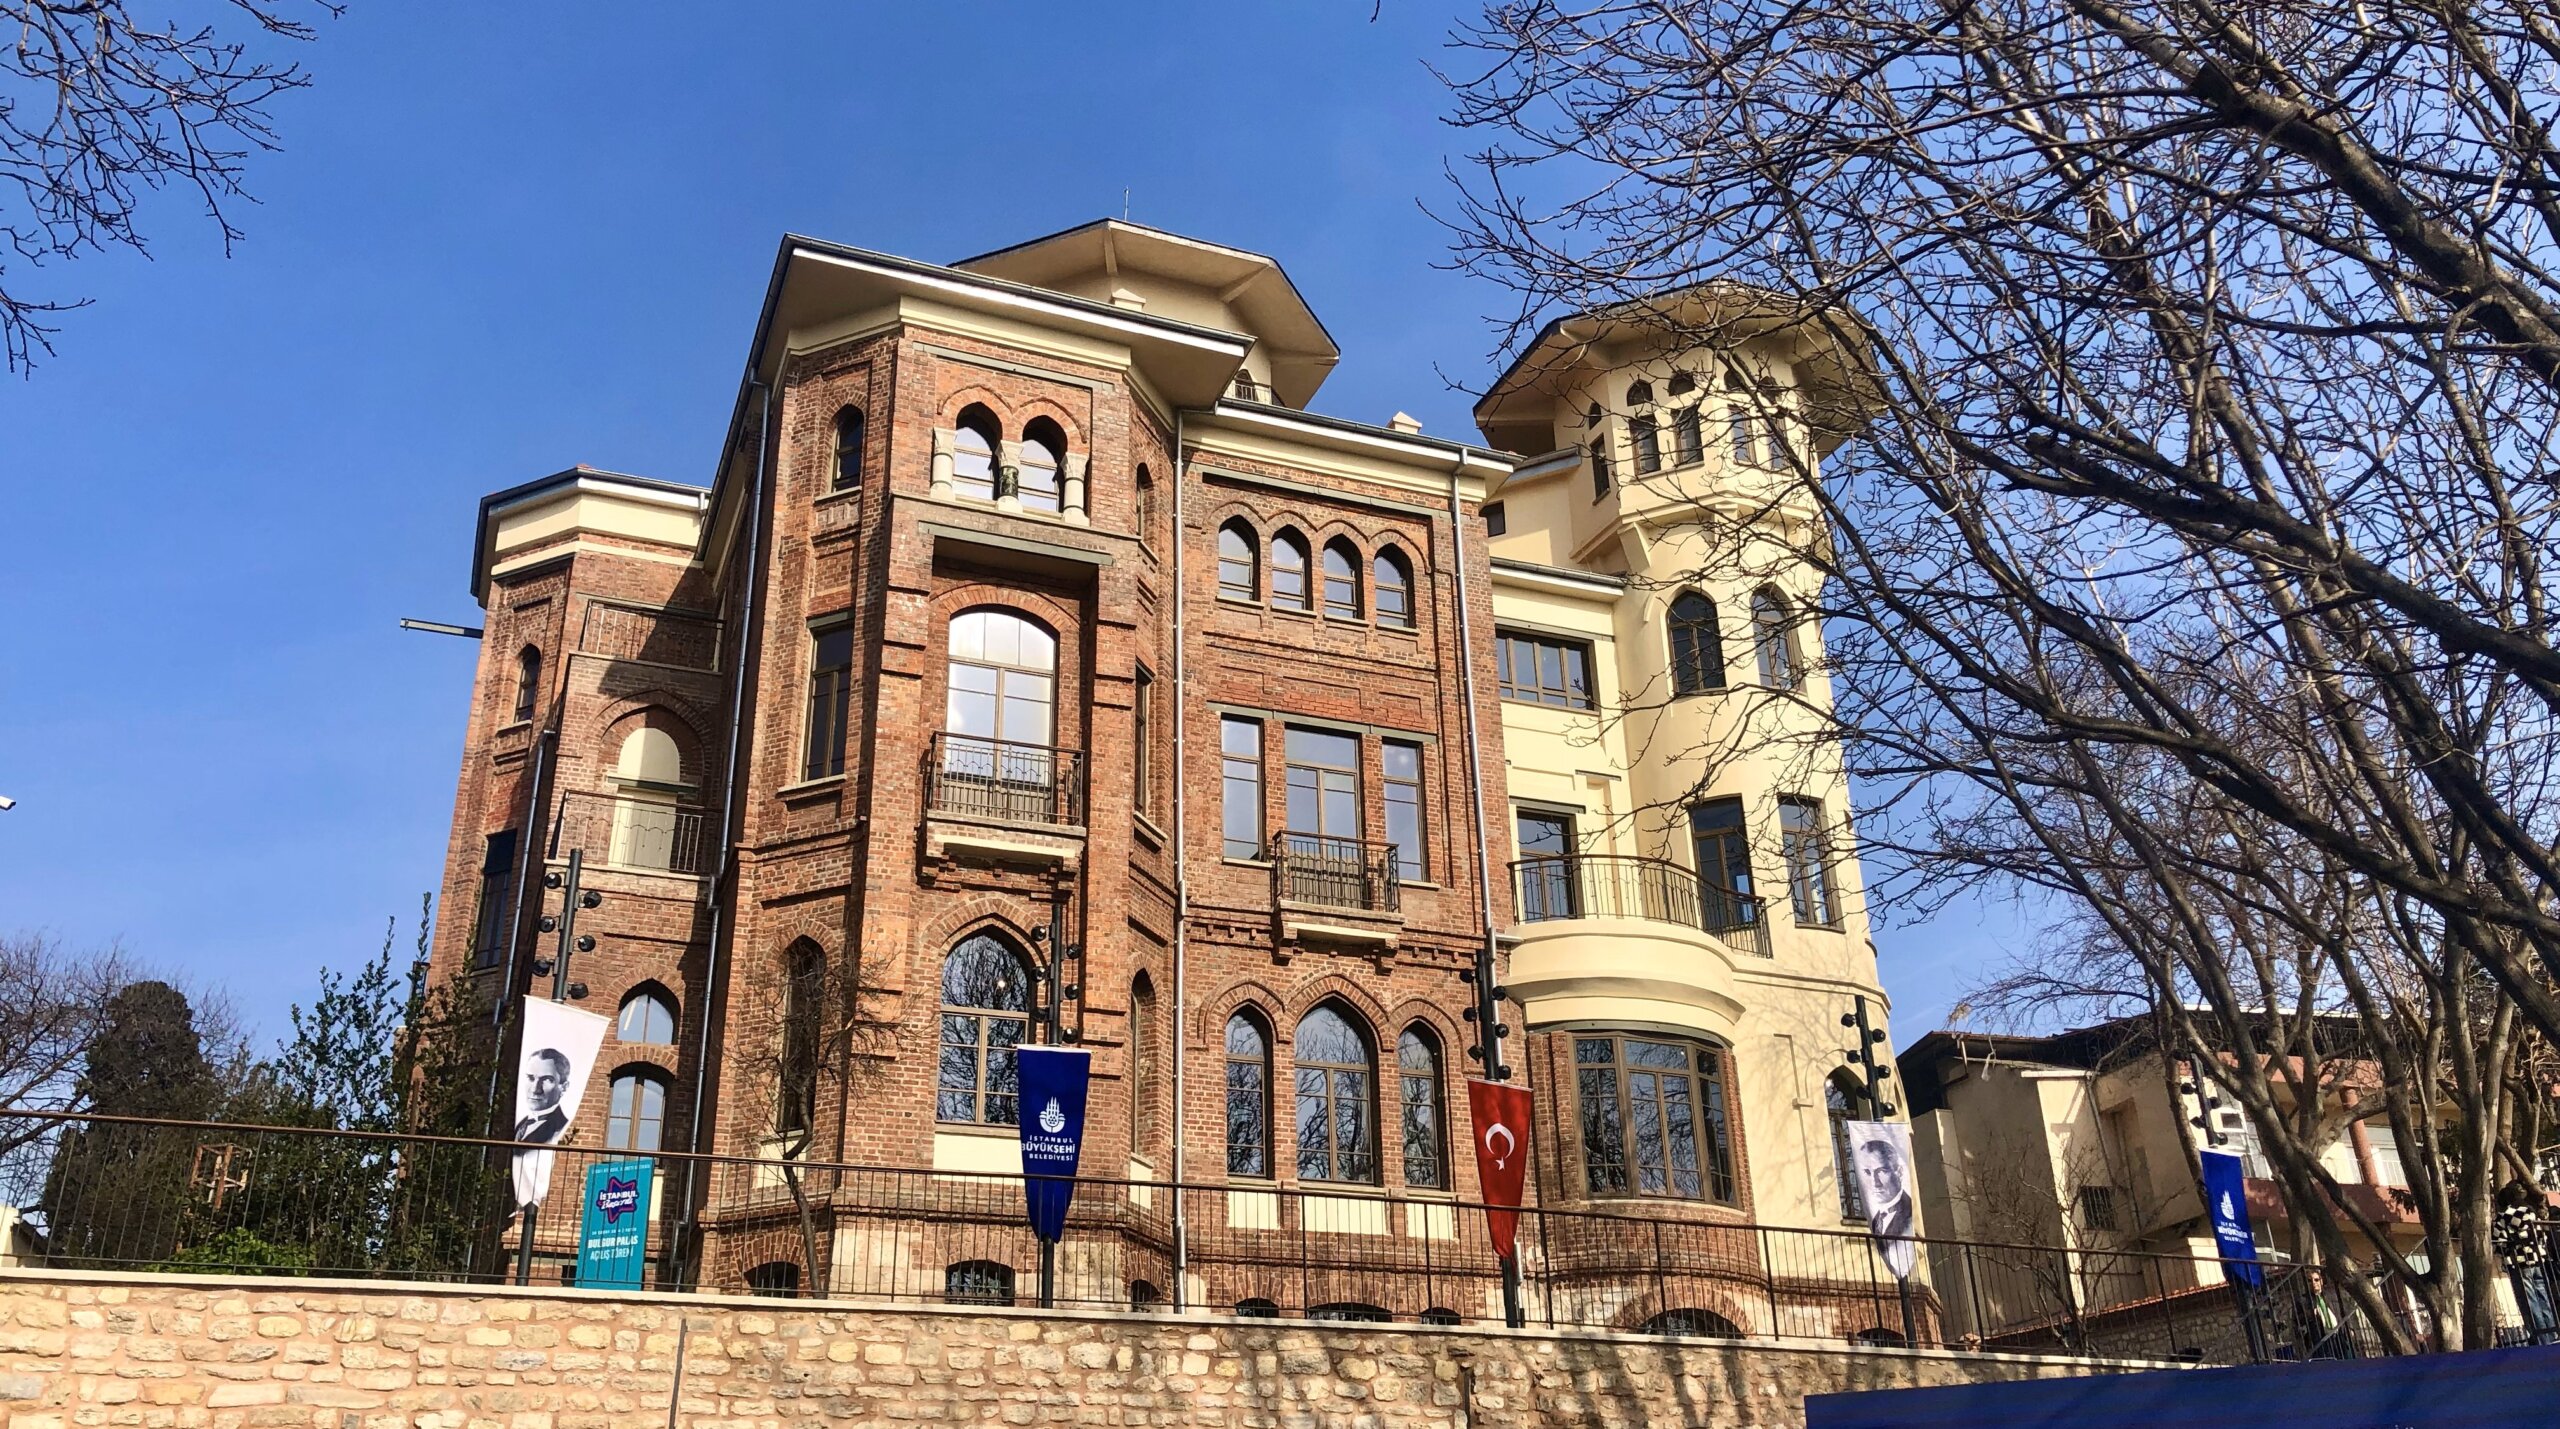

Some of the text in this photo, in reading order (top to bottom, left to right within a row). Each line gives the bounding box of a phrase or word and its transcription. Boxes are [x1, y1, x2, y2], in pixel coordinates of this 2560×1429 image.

[1029, 1135, 1073, 1143] İSTANBUL
[1021, 1141, 1076, 1154] BÜYÜKŞEHİ
[1029, 1153, 1073, 1161] BELEDİYESİ
[588, 1238, 616, 1248] BULGUR
